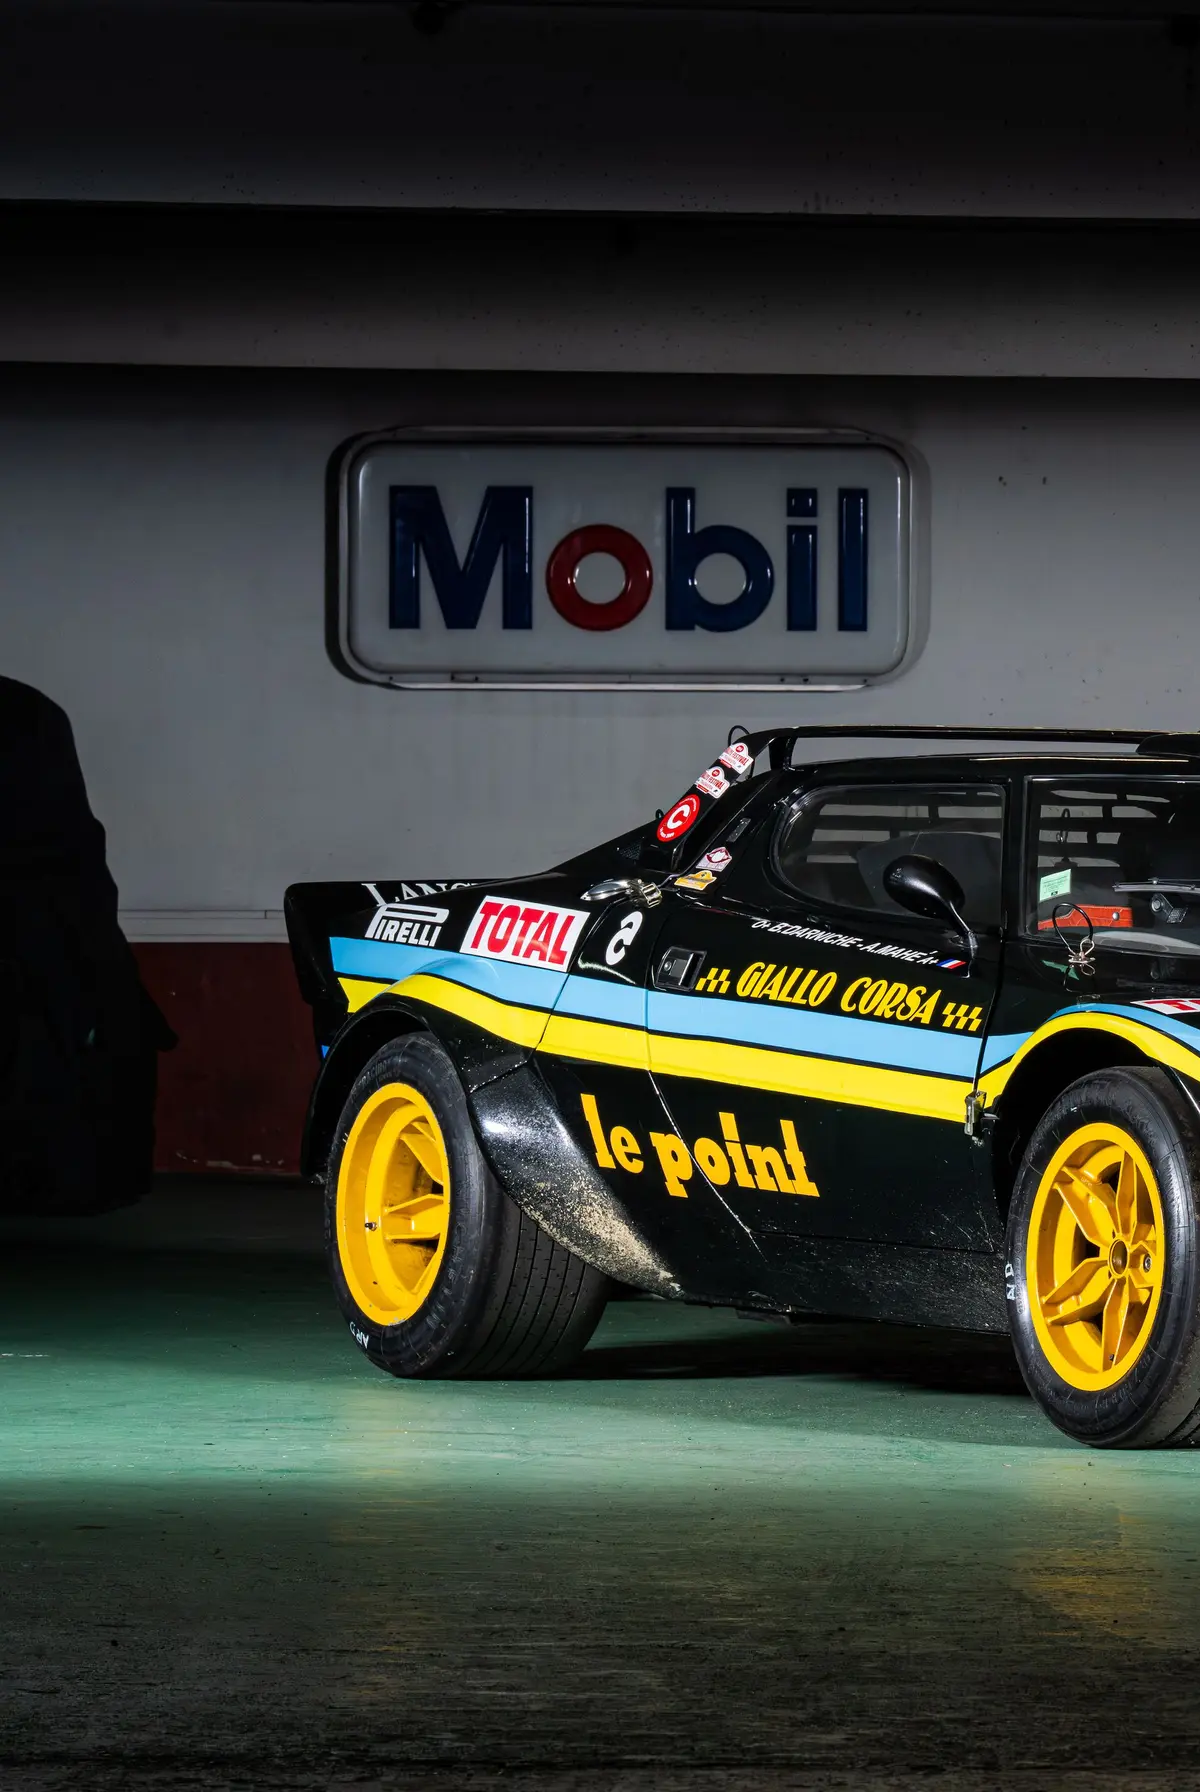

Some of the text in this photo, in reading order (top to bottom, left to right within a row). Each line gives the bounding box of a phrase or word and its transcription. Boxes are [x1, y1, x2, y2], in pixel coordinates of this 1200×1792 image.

[388, 484, 868, 632] Mobil
[364, 903, 450, 947] PIRELLI
[470, 901, 575, 965] TOTAL
[736, 961, 942, 1024] GIALLO CORSA
[580, 1093, 820, 1198] le point
